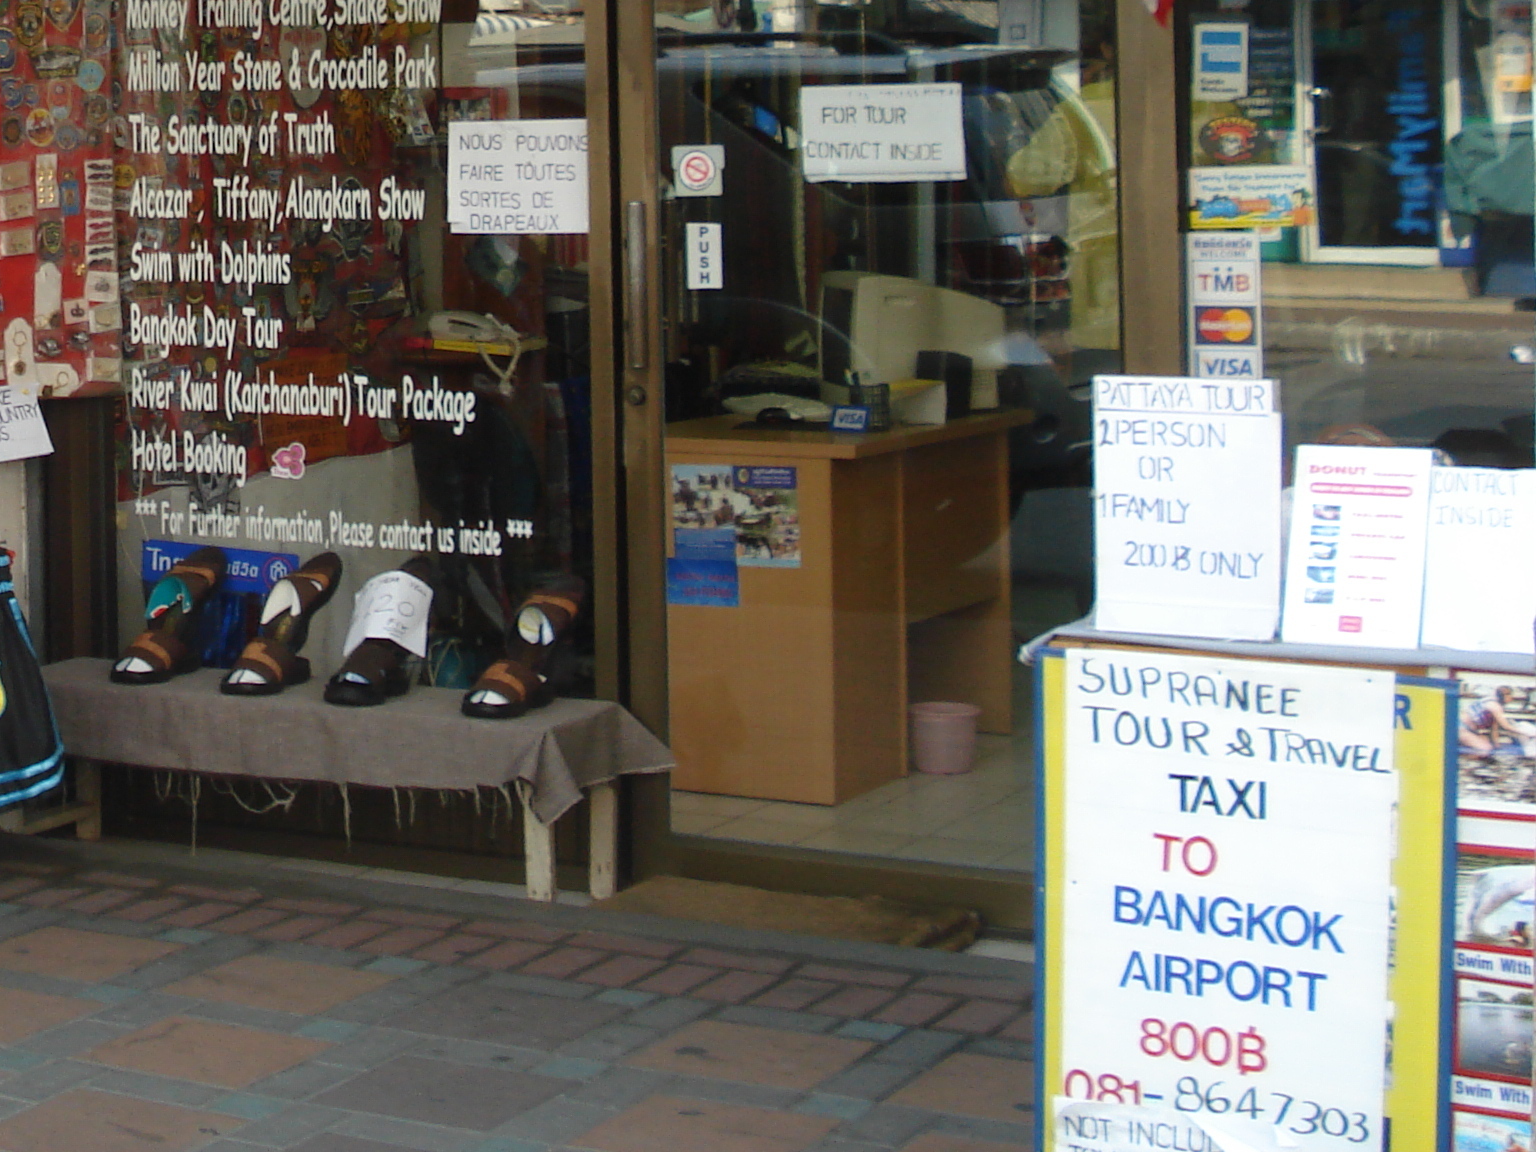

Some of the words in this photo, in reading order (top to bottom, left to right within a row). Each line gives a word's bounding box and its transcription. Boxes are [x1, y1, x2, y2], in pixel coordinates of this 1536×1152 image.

[127, 51, 180, 92] Million
[186, 50, 225, 91] Year
[232, 50, 281, 90] Stone
[289, 48, 301, 89] &
[307, 45, 388, 89] Crocodile
[395, 44, 436, 89] Park
[822, 107, 857, 124] FOR
[864, 105, 907, 125] TOUR
[128, 113, 160, 155] The
[167, 116, 252, 166] Sanctuary
[259, 112, 278, 155] of
[284, 112, 335, 155] Truth
[460, 134, 503, 151] NOUS
[516, 134, 588, 152] POUVONS
[807, 141, 881, 160] CONTACT
[890, 142, 943, 161] INSIDE
[459, 164, 504, 181] FAIRE
[378, 176, 424, 221] Show
[459, 190, 521, 210] SORTES
[532, 191, 554, 209] DE
[470, 213, 560, 231] DRAPEAUX
[130, 242, 172, 282] Swim
[178, 240, 214, 282] with
[221, 240, 291, 295] Dolphins
[698, 226, 711, 285] PUSH
[1197, 266, 1251, 293] TMB
[129, 305, 198, 358] Bangkok
[204, 308, 237, 359] Day
[242, 307, 283, 349] Tour
[1204, 359, 1253, 376] VISA
[131, 371, 174, 410] River
[180, 371, 218, 414] Kwai
[224, 370, 352, 426] (Kanchanaburi)
[354, 375, 398, 419] Tour
[402, 375, 476, 436] Package
[1096, 379, 1193, 408] PATTAYA
[1201, 384, 1265, 411] TOUR
[838, 413, 864, 425] VISA
[132, 433, 175, 473] Hotel
[182, 431, 247, 486] Booking
[1137, 455, 1175, 482] OR
[1432, 470, 1520, 496] CONTACT
[1111, 494, 1191, 524] FAMILY
[1435, 505, 1513, 528] INSIDE
[160, 501, 183, 537] For
[188, 502, 241, 539] Further
[379, 518, 433, 552] contact
[437, 528, 454, 553] us
[459, 521, 502, 556] inside
[1200, 550, 1264, 579] ONLY
[1077, 657, 1302, 718] SUPRANEE
[1081, 704, 1210, 756] TOUR
[1226, 728, 1255, 758] &
[1258, 727, 1392, 774] TRAVEL
[1169, 773, 1267, 820] TAXI
[1153, 833, 1219, 877] TO
[1113, 885, 1344, 953] BANGKOK
[1455, 952, 1494, 971] Swim
[1500, 956, 1532, 976] With
[1118, 950, 1328, 1012] AIRPORT
[1455, 1079, 1493, 1100] Swim
[1499, 1083, 1531, 1105] With
[1064, 1115, 1111, 1142] NOT
